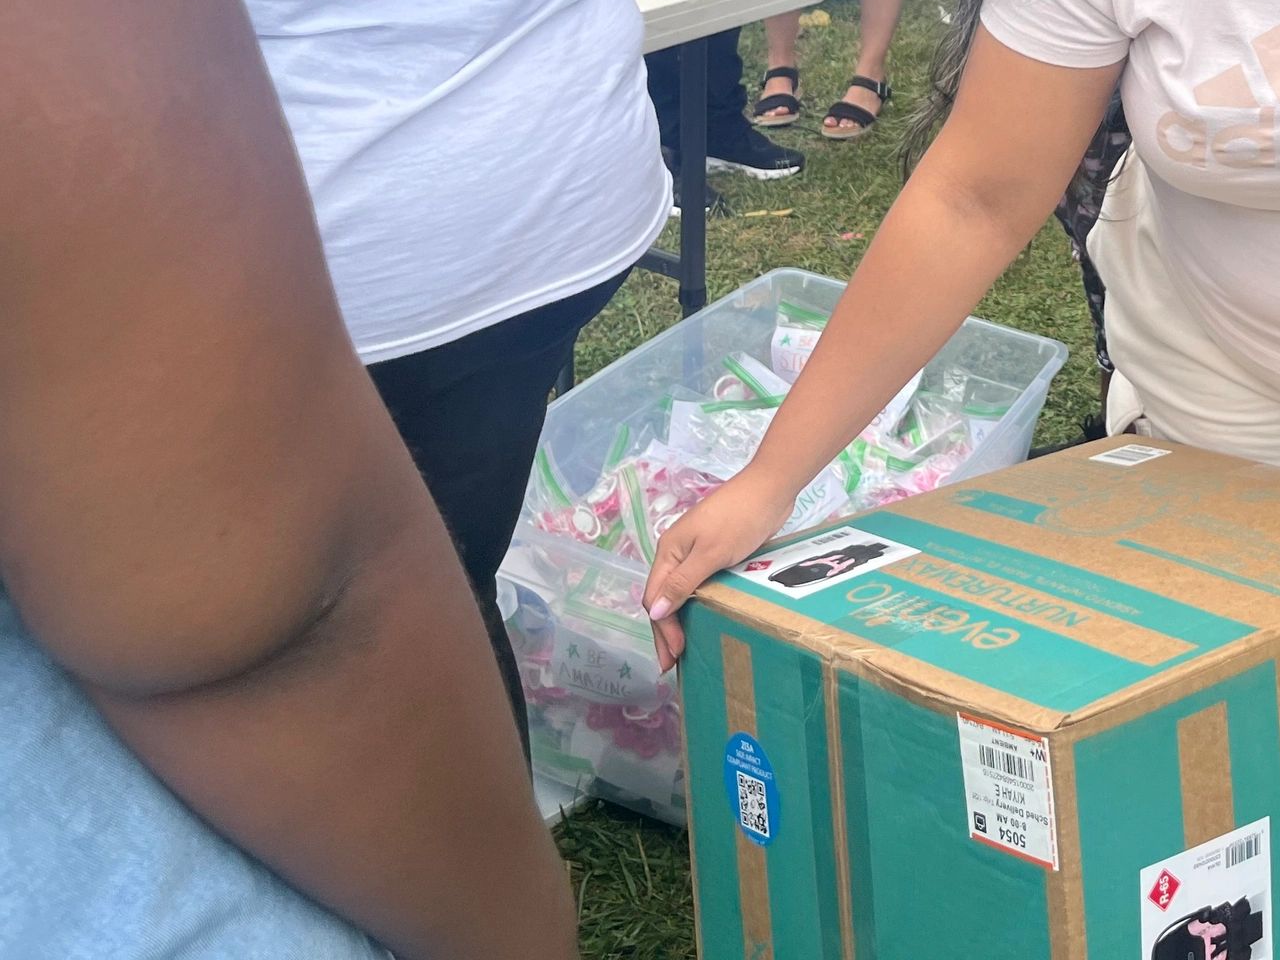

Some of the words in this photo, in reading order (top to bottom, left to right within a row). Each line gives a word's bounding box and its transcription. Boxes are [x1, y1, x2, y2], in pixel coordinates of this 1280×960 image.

[995, 798, 1024, 816] Delivery
[996, 813, 1008, 824] AM
[1026, 811, 1049, 826] Sched
[999, 826, 1026, 848] 5054
[1159, 875, 1170, 905] R-65
